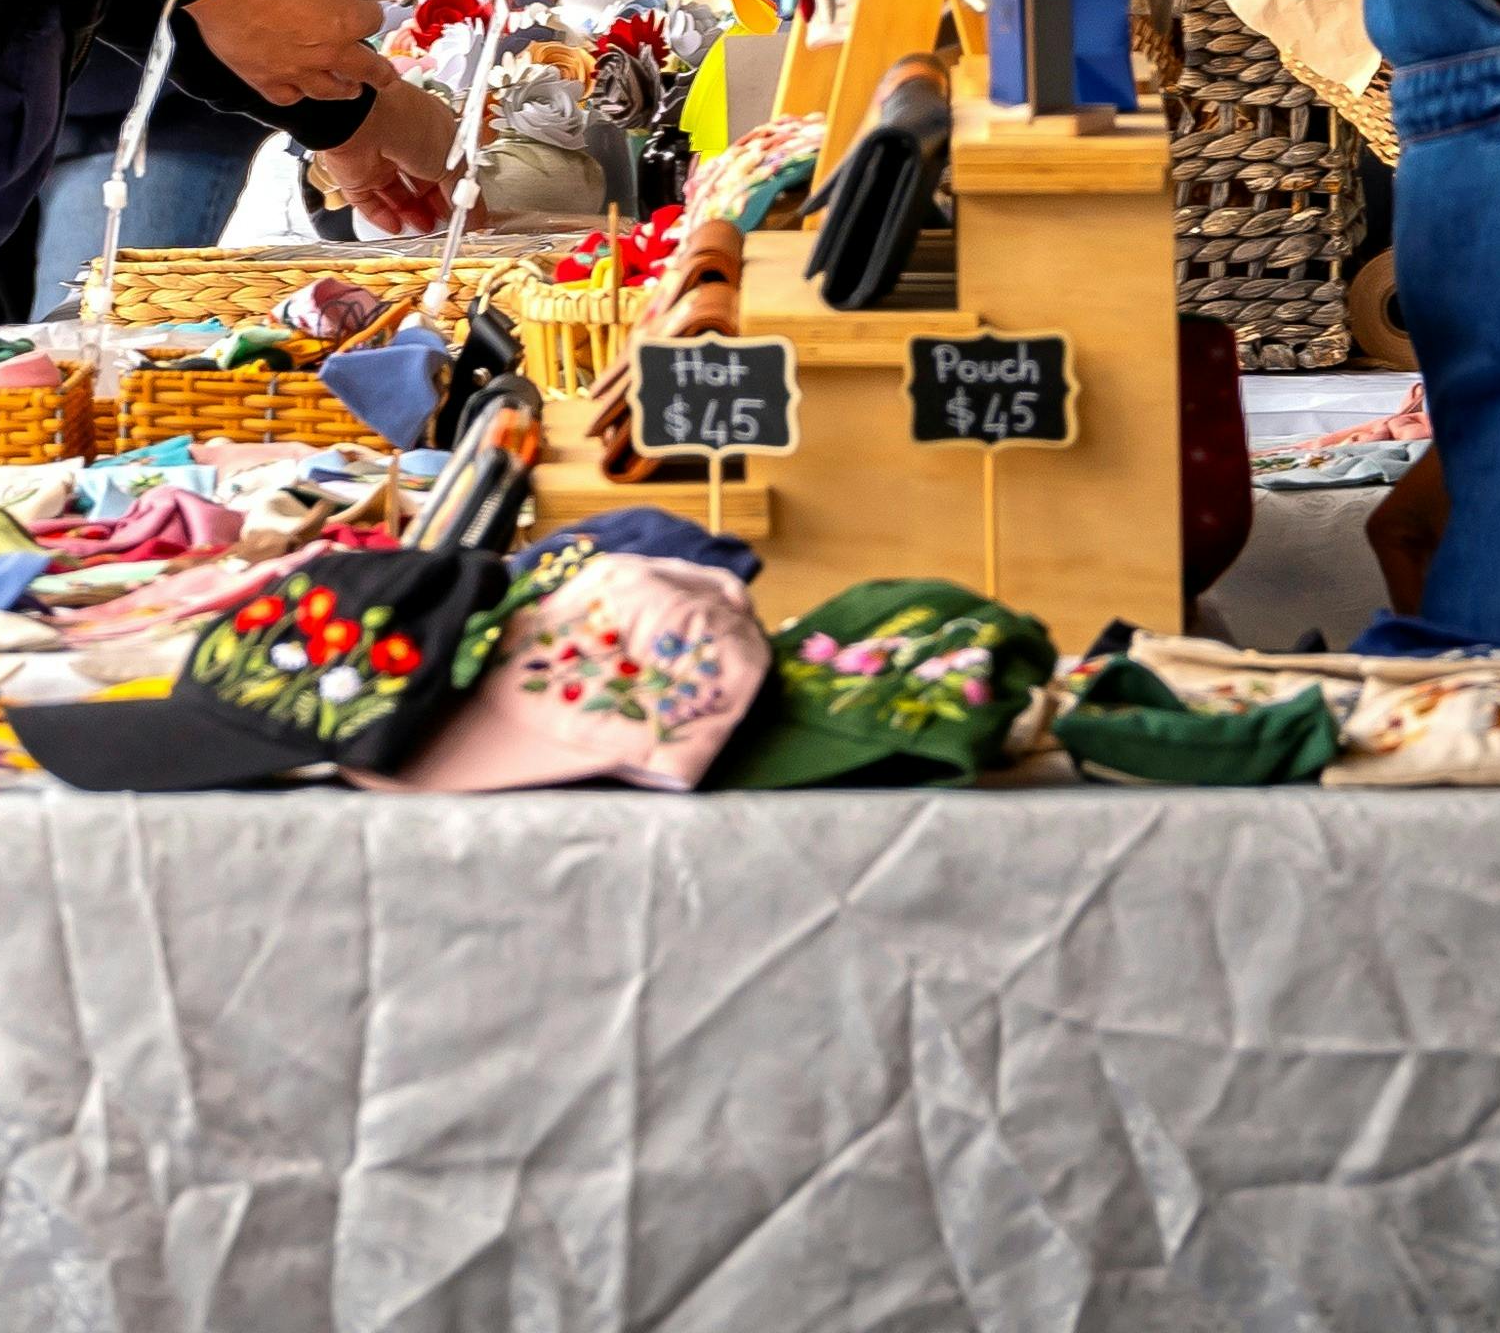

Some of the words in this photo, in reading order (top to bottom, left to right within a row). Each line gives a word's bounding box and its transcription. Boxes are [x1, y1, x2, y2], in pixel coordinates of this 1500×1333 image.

[930, 341, 1041, 385] Pouch
[663, 394, 766, 445] $45
[944, 385, 1040, 438] $45
